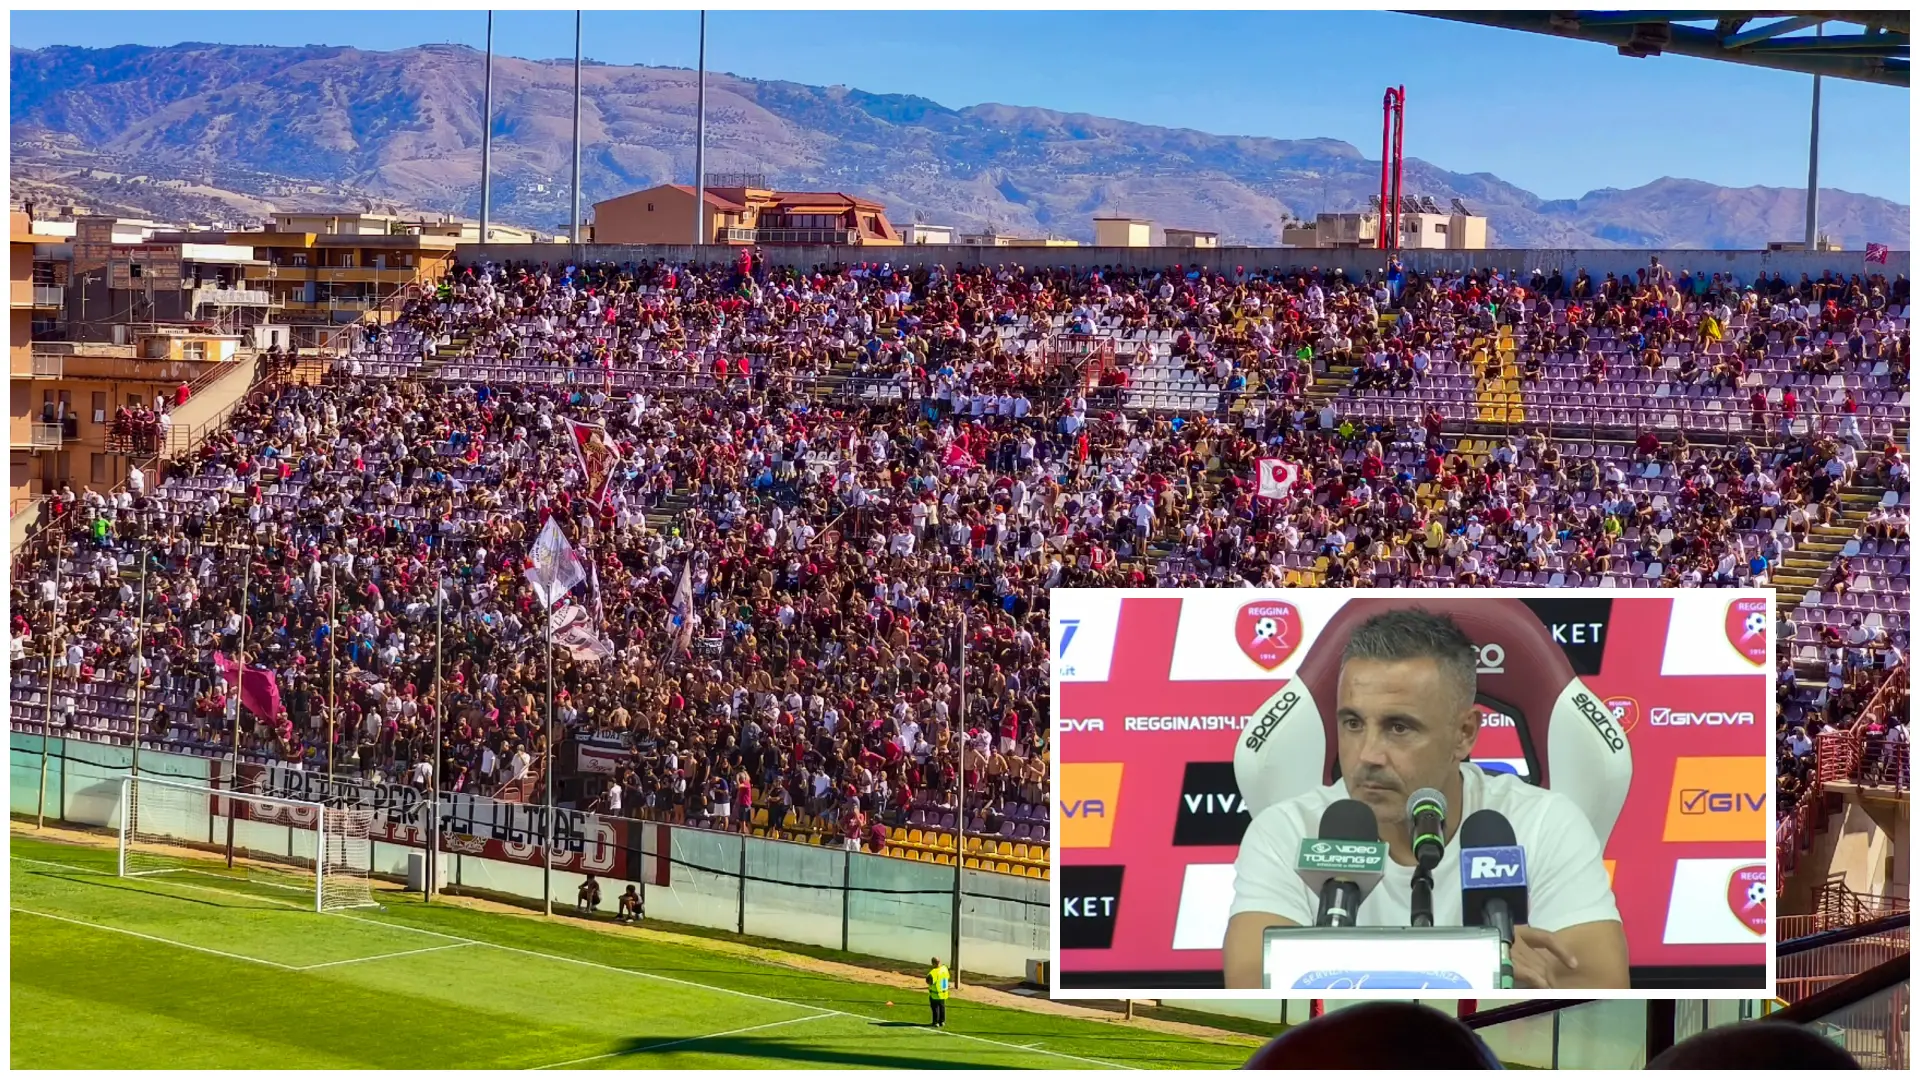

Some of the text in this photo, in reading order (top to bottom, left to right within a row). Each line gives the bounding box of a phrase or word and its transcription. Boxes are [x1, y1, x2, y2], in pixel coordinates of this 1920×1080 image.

[1248, 607, 1289, 616] REGGINA
[1552, 623, 1603, 643] KET
[1060, 665, 1076, 676] .it
[1246, 691, 1297, 750] sparco
[1574, 692, 1624, 751] sparco
[1670, 712, 1754, 725] GIVOVA
[1709, 792, 1766, 812] GIV
[1063, 897, 1115, 917] KET
